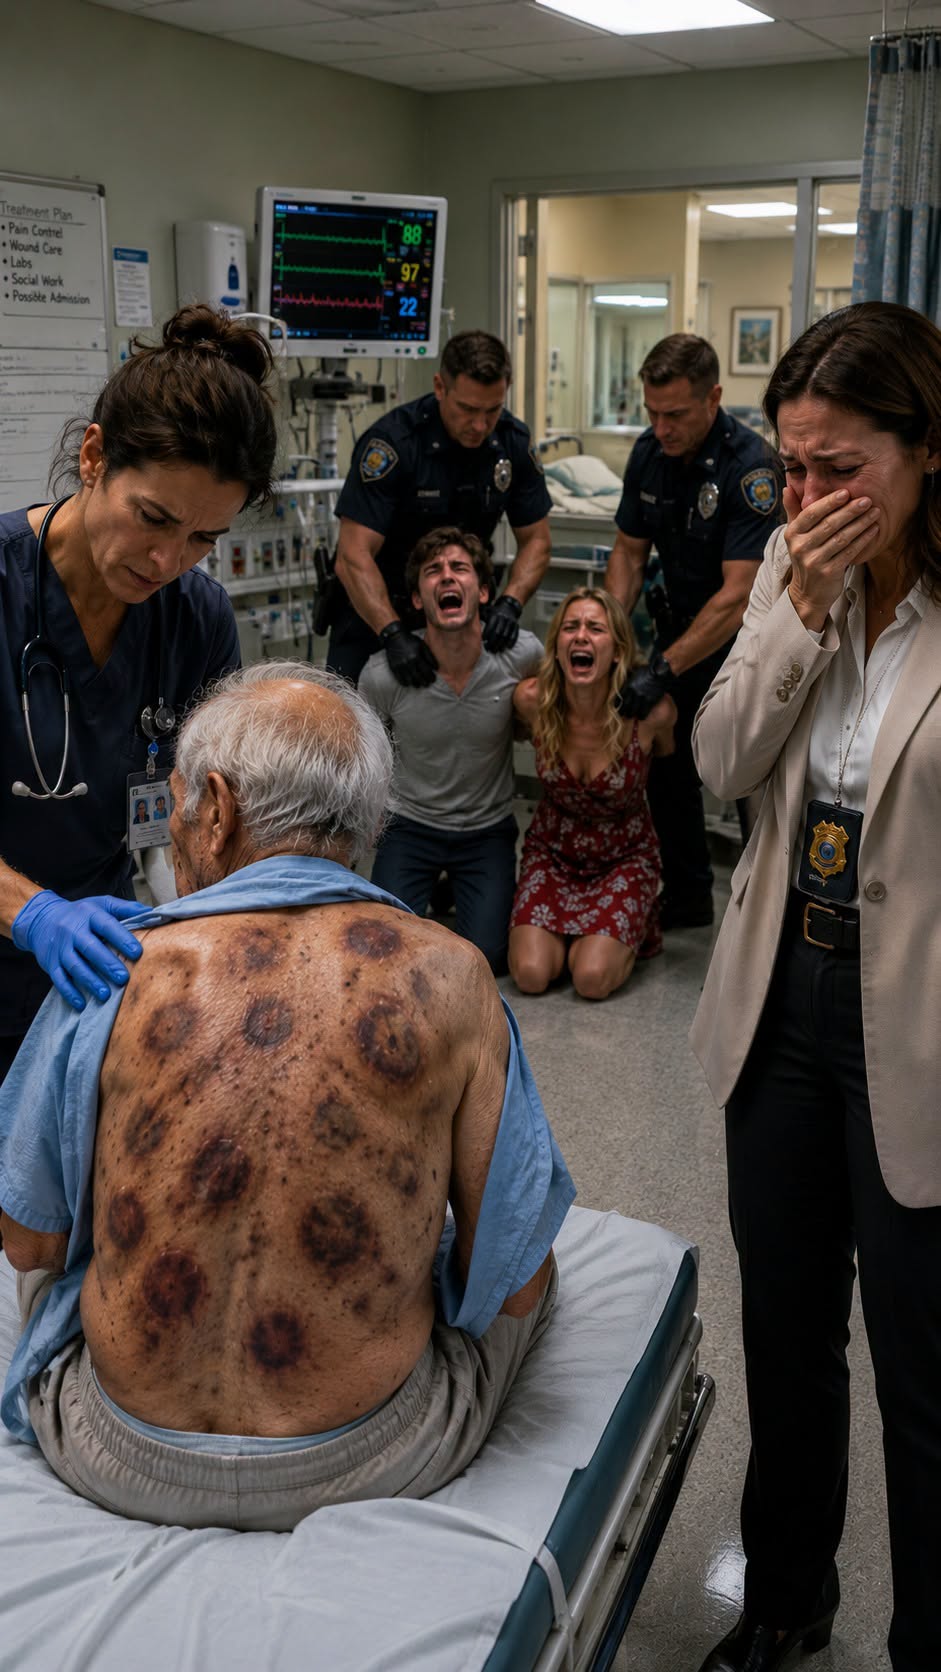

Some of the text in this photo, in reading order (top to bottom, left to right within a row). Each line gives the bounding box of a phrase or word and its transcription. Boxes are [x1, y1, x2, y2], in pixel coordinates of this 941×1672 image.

[0, 200, 73, 221] Treatment Plan
[8, 222, 29, 235] Pain
[402, 224, 422, 245] 88
[9, 239, 63, 256] Wound Care
[10, 255, 33, 269] Labs
[12, 272, 64, 288] Social Work
[401, 263, 420, 282] 97
[50, 291, 91, 304] Admission
[399, 296, 418, 316] 22
